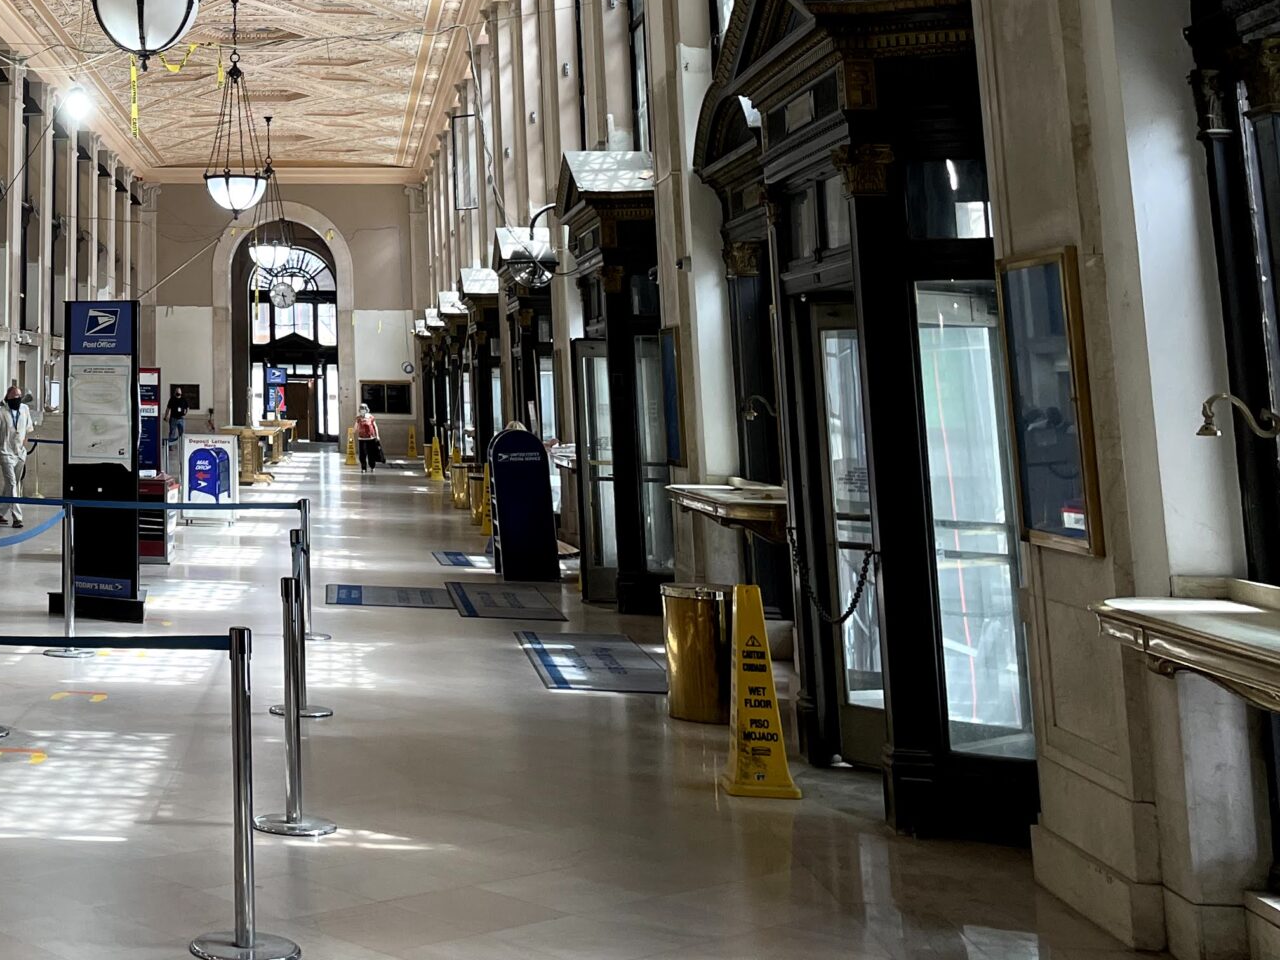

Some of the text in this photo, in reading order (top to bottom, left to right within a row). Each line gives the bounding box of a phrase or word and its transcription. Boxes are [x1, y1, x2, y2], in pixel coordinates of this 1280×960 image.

[99, 583, 113, 591] MAIL
[742, 650, 766, 660] CAUTION
[748, 686, 767, 696] WET
[744, 699, 772, 709] FLOOR
[750, 718, 769, 729] PISO
[742, 731, 778, 742] MOJADO
